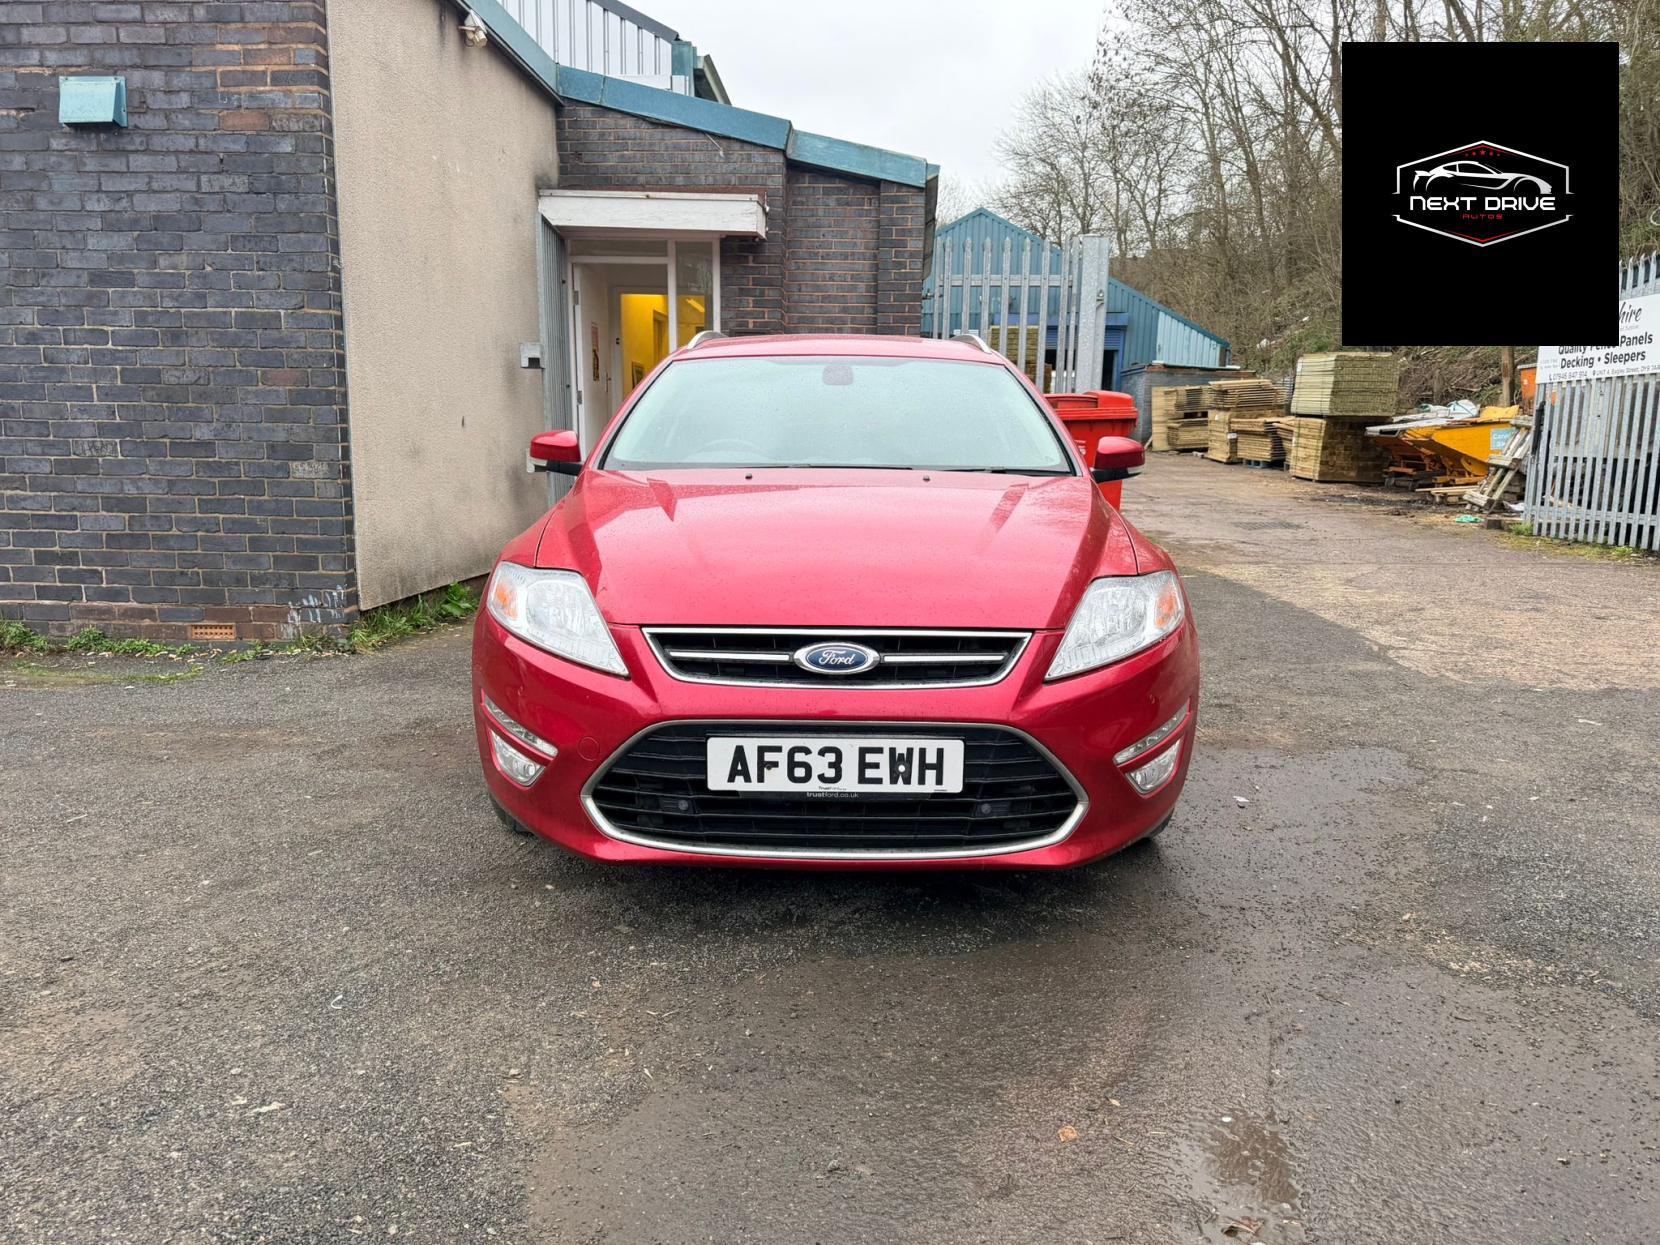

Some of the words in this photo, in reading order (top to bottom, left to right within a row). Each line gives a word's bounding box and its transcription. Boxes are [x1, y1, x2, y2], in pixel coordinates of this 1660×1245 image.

[1620, 331, 1653, 347] Panels
[1560, 355, 1594, 369] Decking
[1604, 350, 1646, 365] Sleepers
[819, 650, 854, 665] Ford
[727, 745, 843, 784] AF63
[857, 746, 945, 786] EWH
